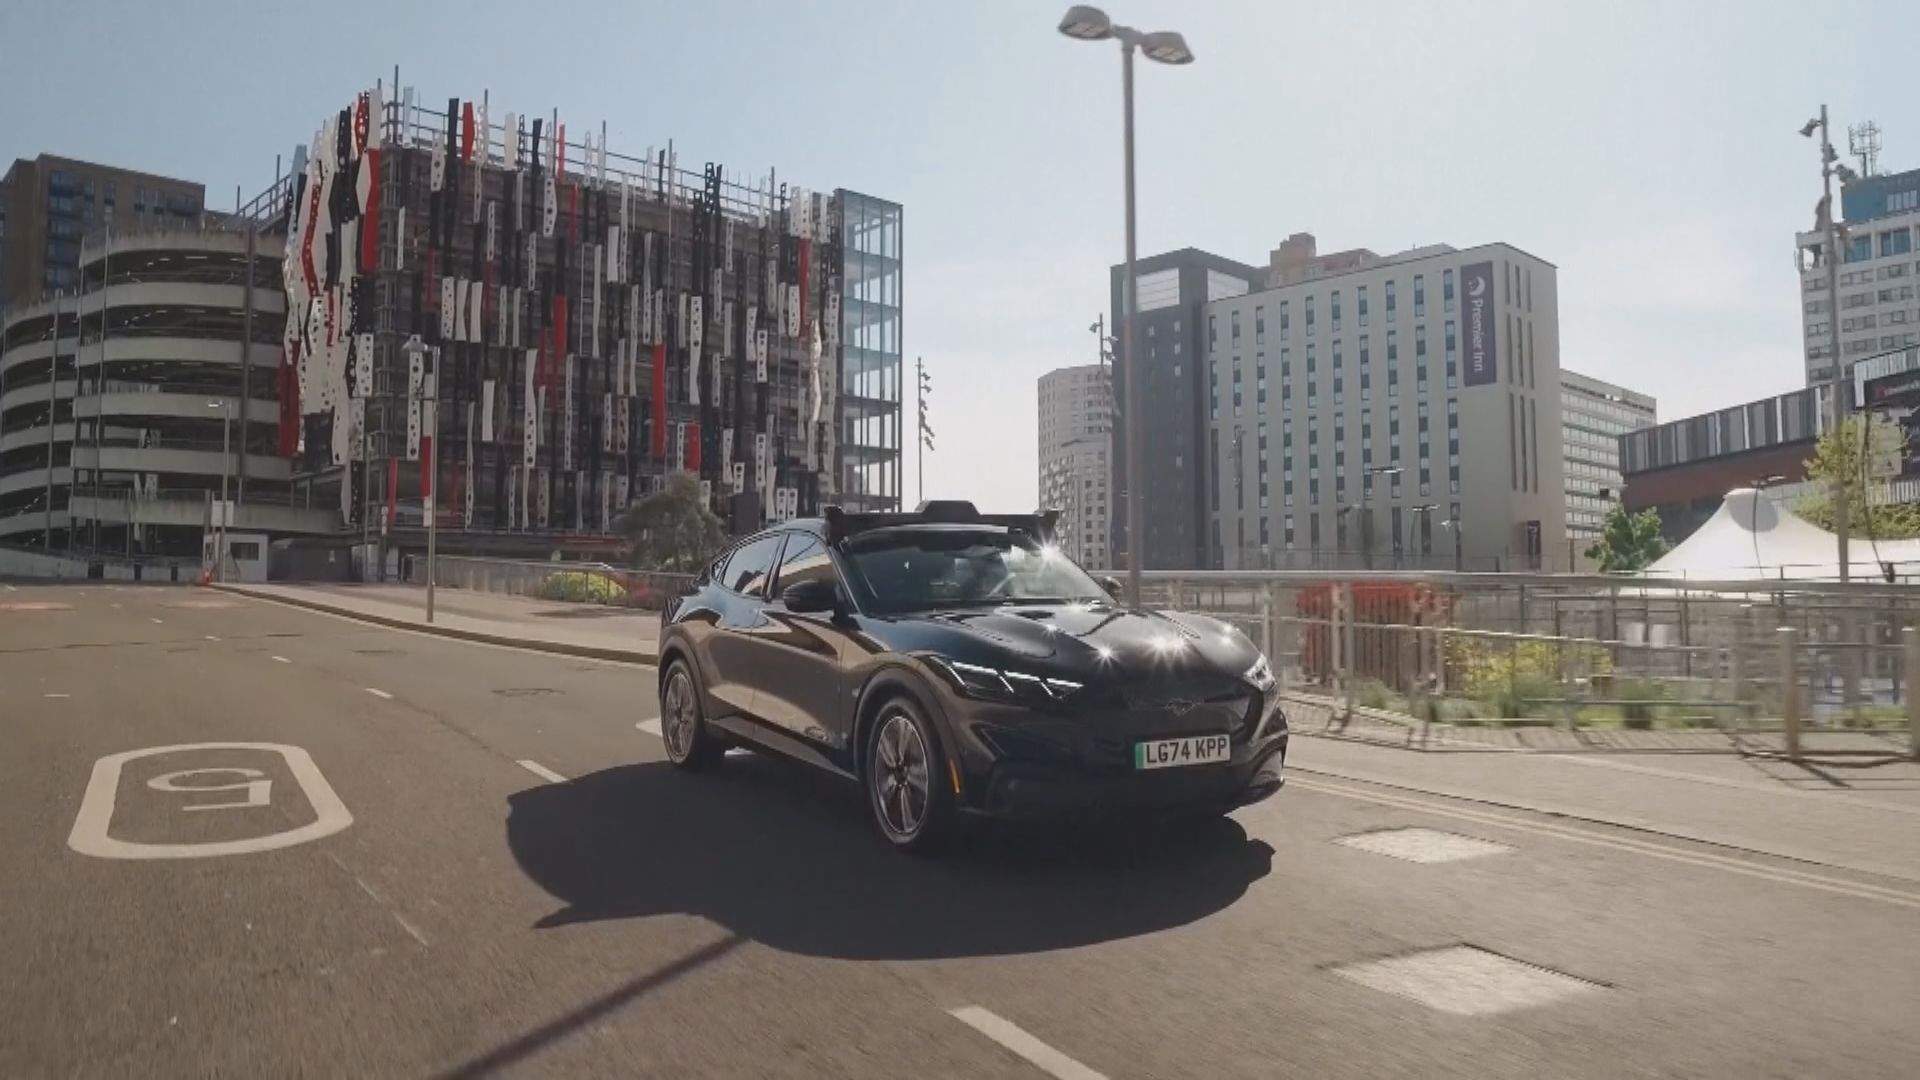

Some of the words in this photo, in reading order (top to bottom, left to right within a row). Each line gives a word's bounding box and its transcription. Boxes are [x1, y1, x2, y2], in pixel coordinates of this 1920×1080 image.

[1471, 298, 1485, 349] Premier
[1473, 352, 1485, 372] Inn
[1146, 741, 1191, 763] LG74
[1195, 738, 1227, 759] KPP
